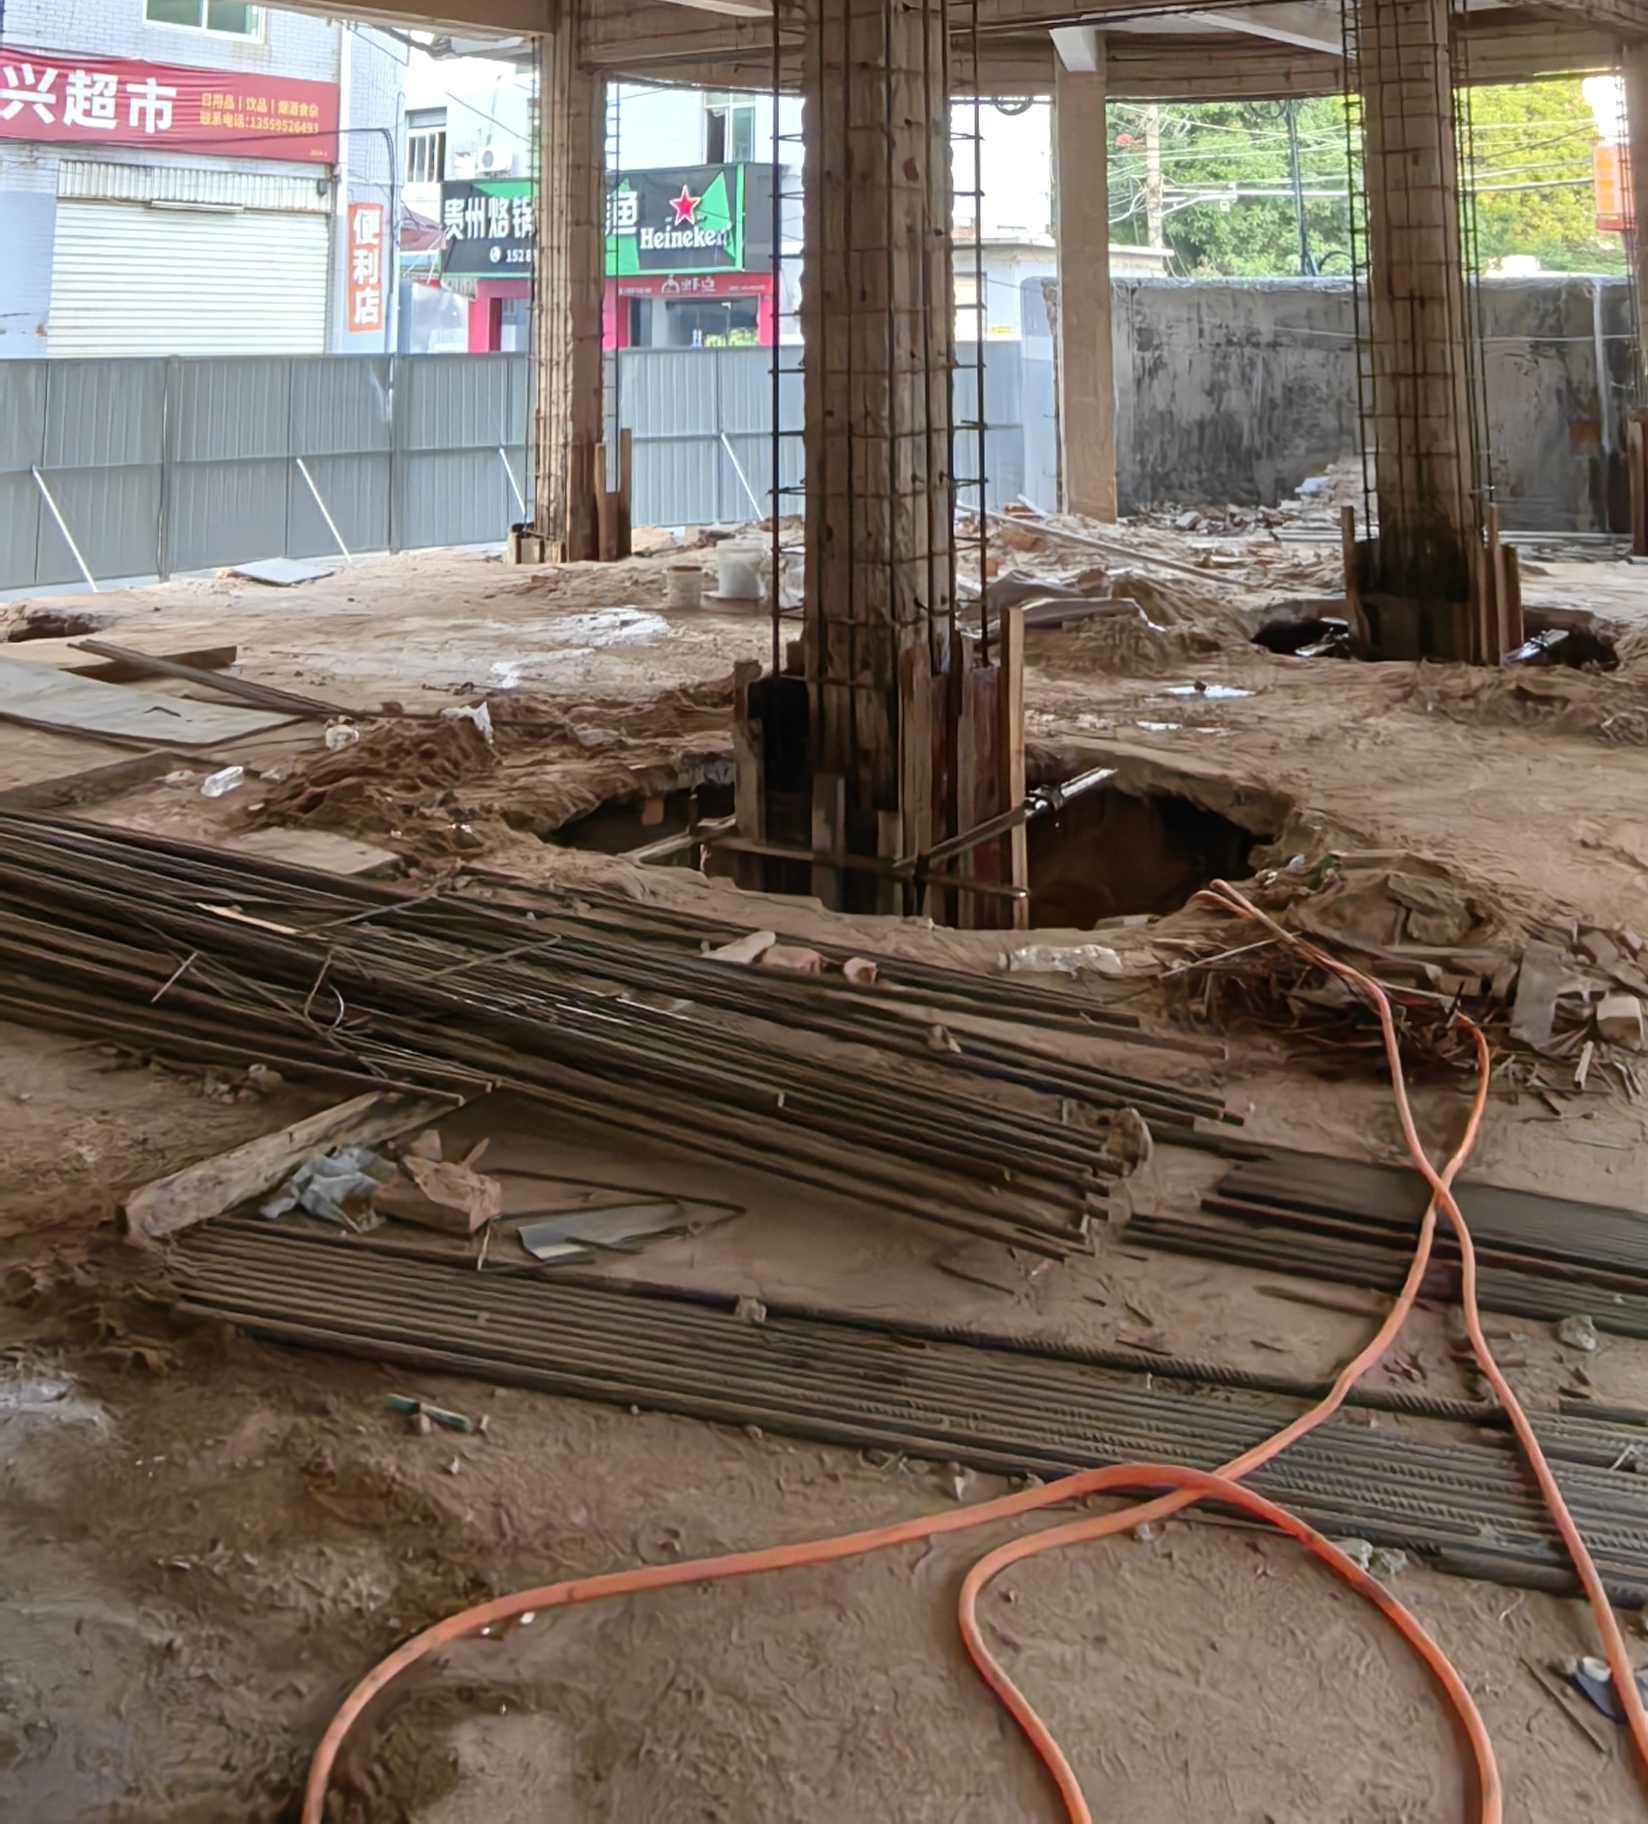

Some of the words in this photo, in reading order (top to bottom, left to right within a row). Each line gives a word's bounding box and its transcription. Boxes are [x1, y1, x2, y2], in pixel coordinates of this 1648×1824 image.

[0, 63, 177, 134] 兴超市
[353, 209, 380, 325] 便利店
[640, 225, 730, 250] Heineken
